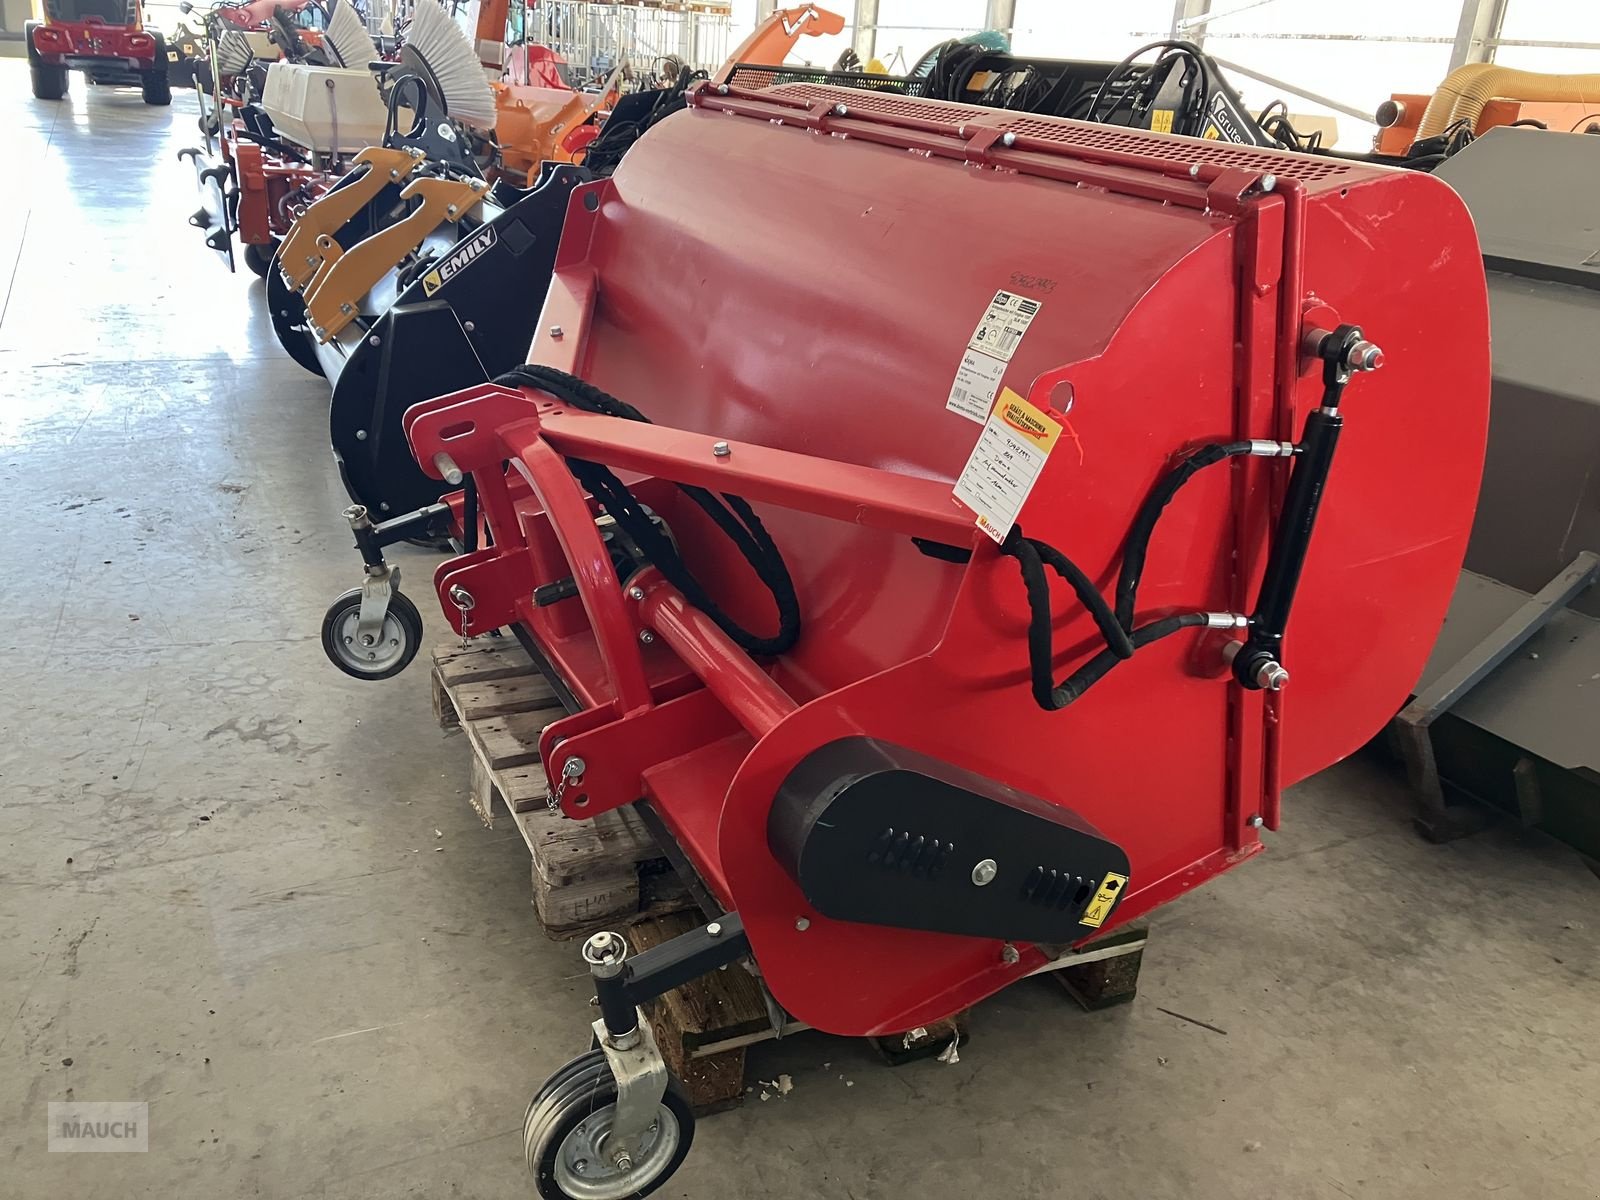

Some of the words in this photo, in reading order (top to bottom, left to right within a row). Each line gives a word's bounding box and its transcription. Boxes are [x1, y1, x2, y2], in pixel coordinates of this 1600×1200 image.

[1217, 110, 1248, 145] Grute
[439, 229, 493, 281] EMILY
[1025, 414, 1046, 433] MASCHINEN
[979, 517, 1001, 539] MAUCH
